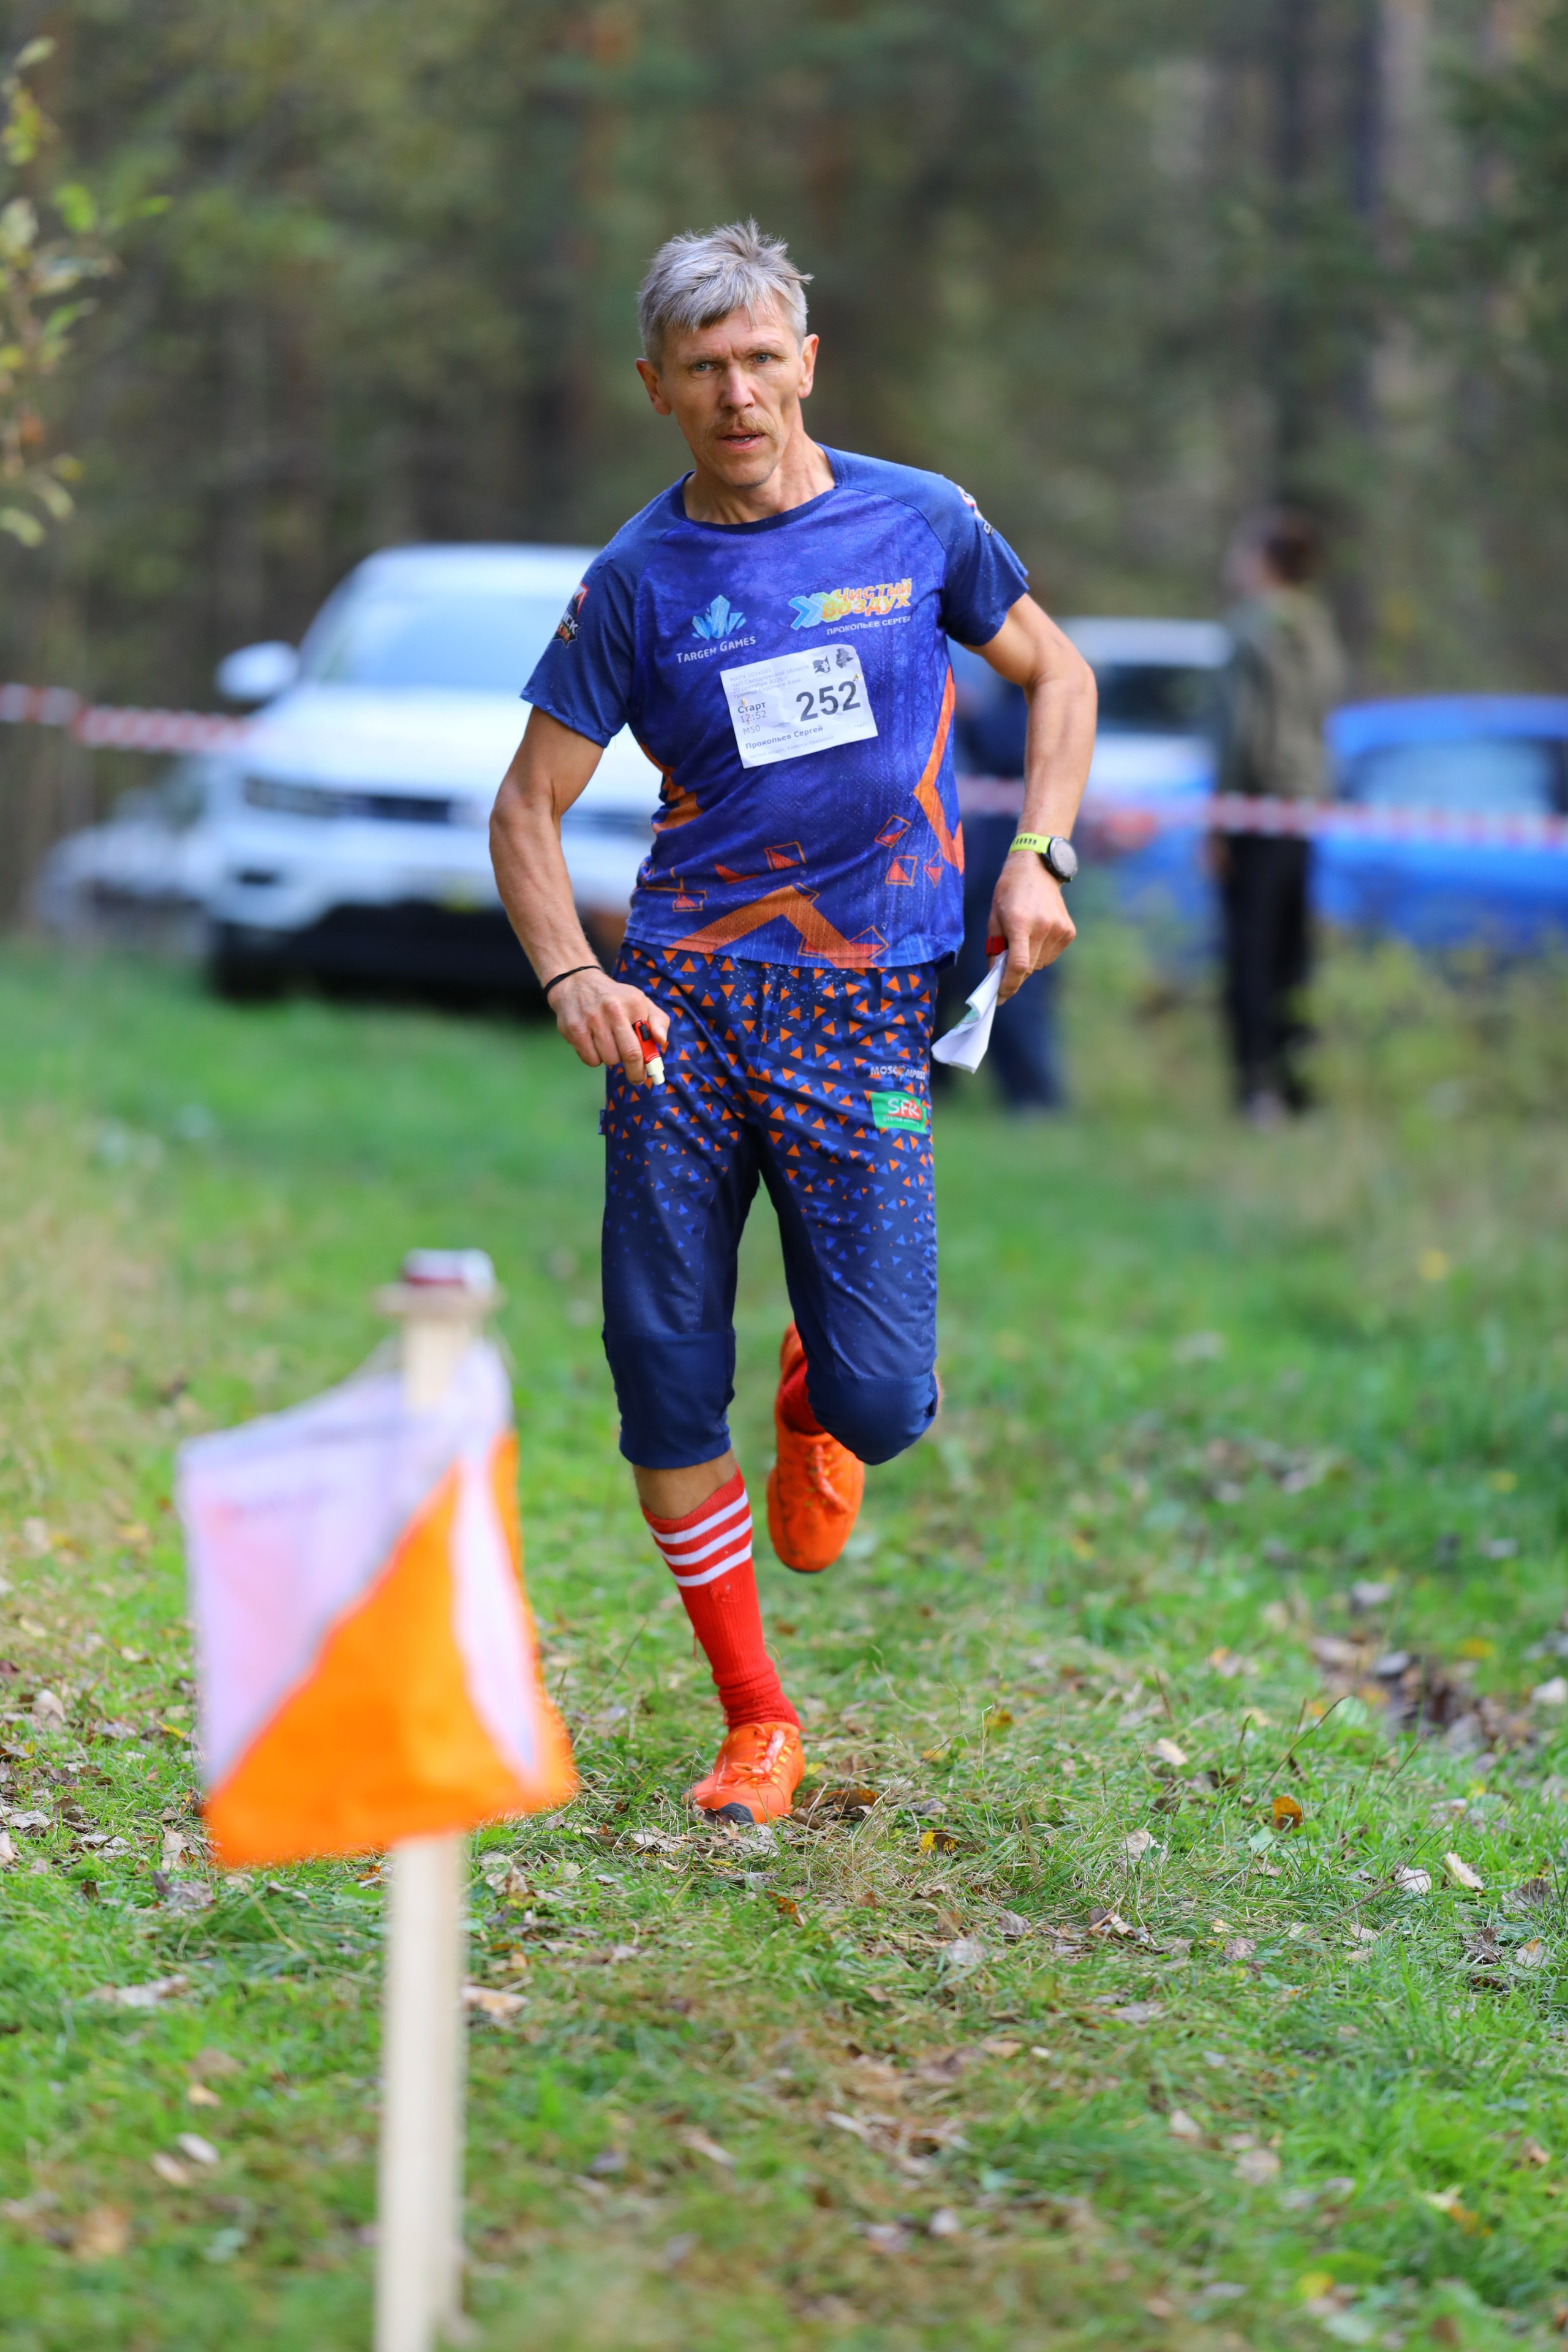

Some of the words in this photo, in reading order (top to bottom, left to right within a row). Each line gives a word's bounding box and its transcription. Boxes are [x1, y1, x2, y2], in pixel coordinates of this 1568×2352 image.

[836, 578, 912, 602] ЧИСТЫЙ
[821, 594, 911, 619] ВОЗДУХ
[827, 620, 880, 636] ПРОКОПЬЕВ
[744, 671, 785, 684] Свердловской
[786, 665, 809, 674] области
[741, 682, 767, 692] сентября
[737, 702, 766, 714] Старт
[796, 680, 861, 722] 252
[740, 710, 767, 723] 12:52
[745, 734, 792, 750] Прокопьев
[794, 725, 824, 737] Сергей
